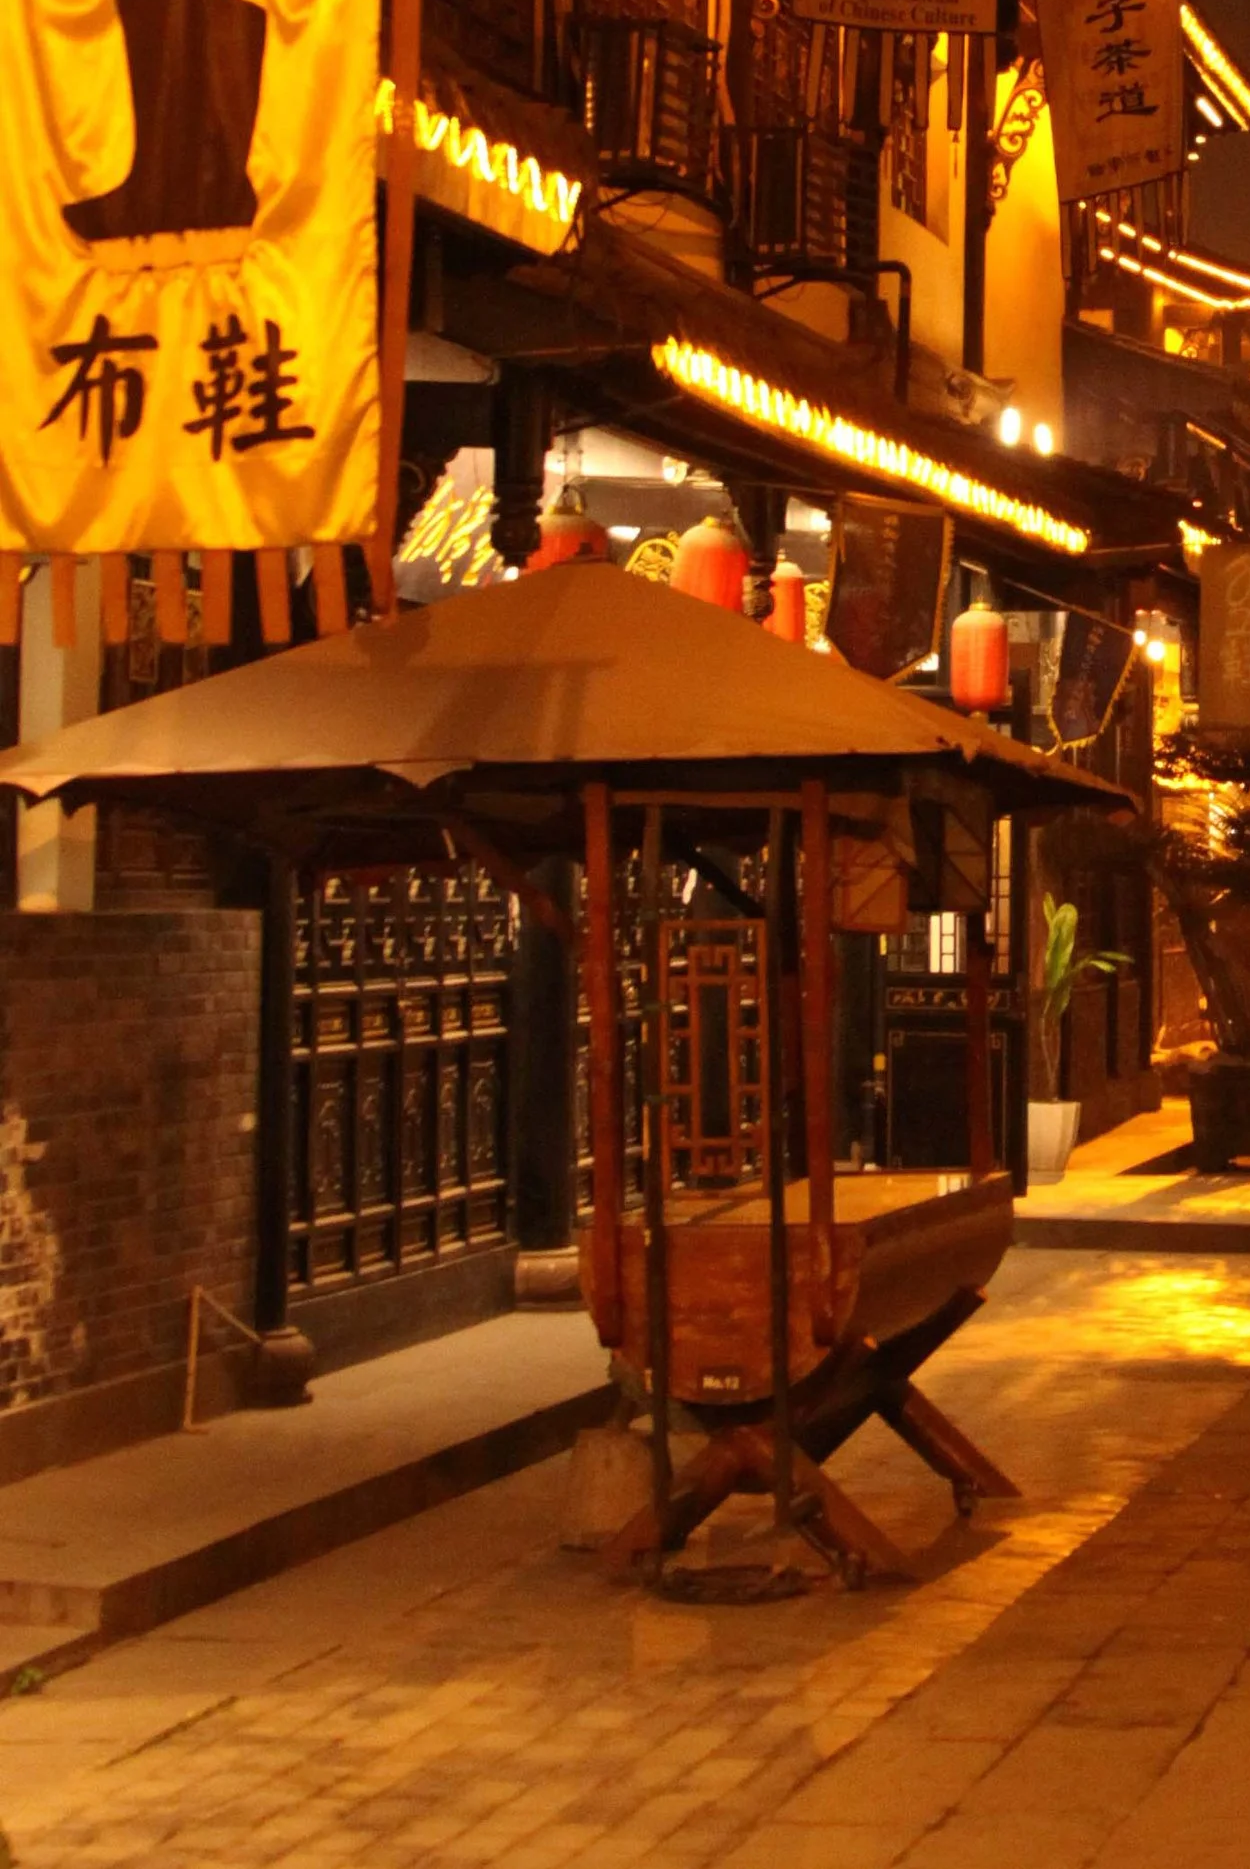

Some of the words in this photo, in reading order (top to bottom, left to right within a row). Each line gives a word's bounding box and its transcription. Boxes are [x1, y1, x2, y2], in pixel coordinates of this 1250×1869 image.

[839, 0, 907, 22] Chinese
[910, 5, 978, 27] Culture
[37, 312, 316, 468] 布鞋
